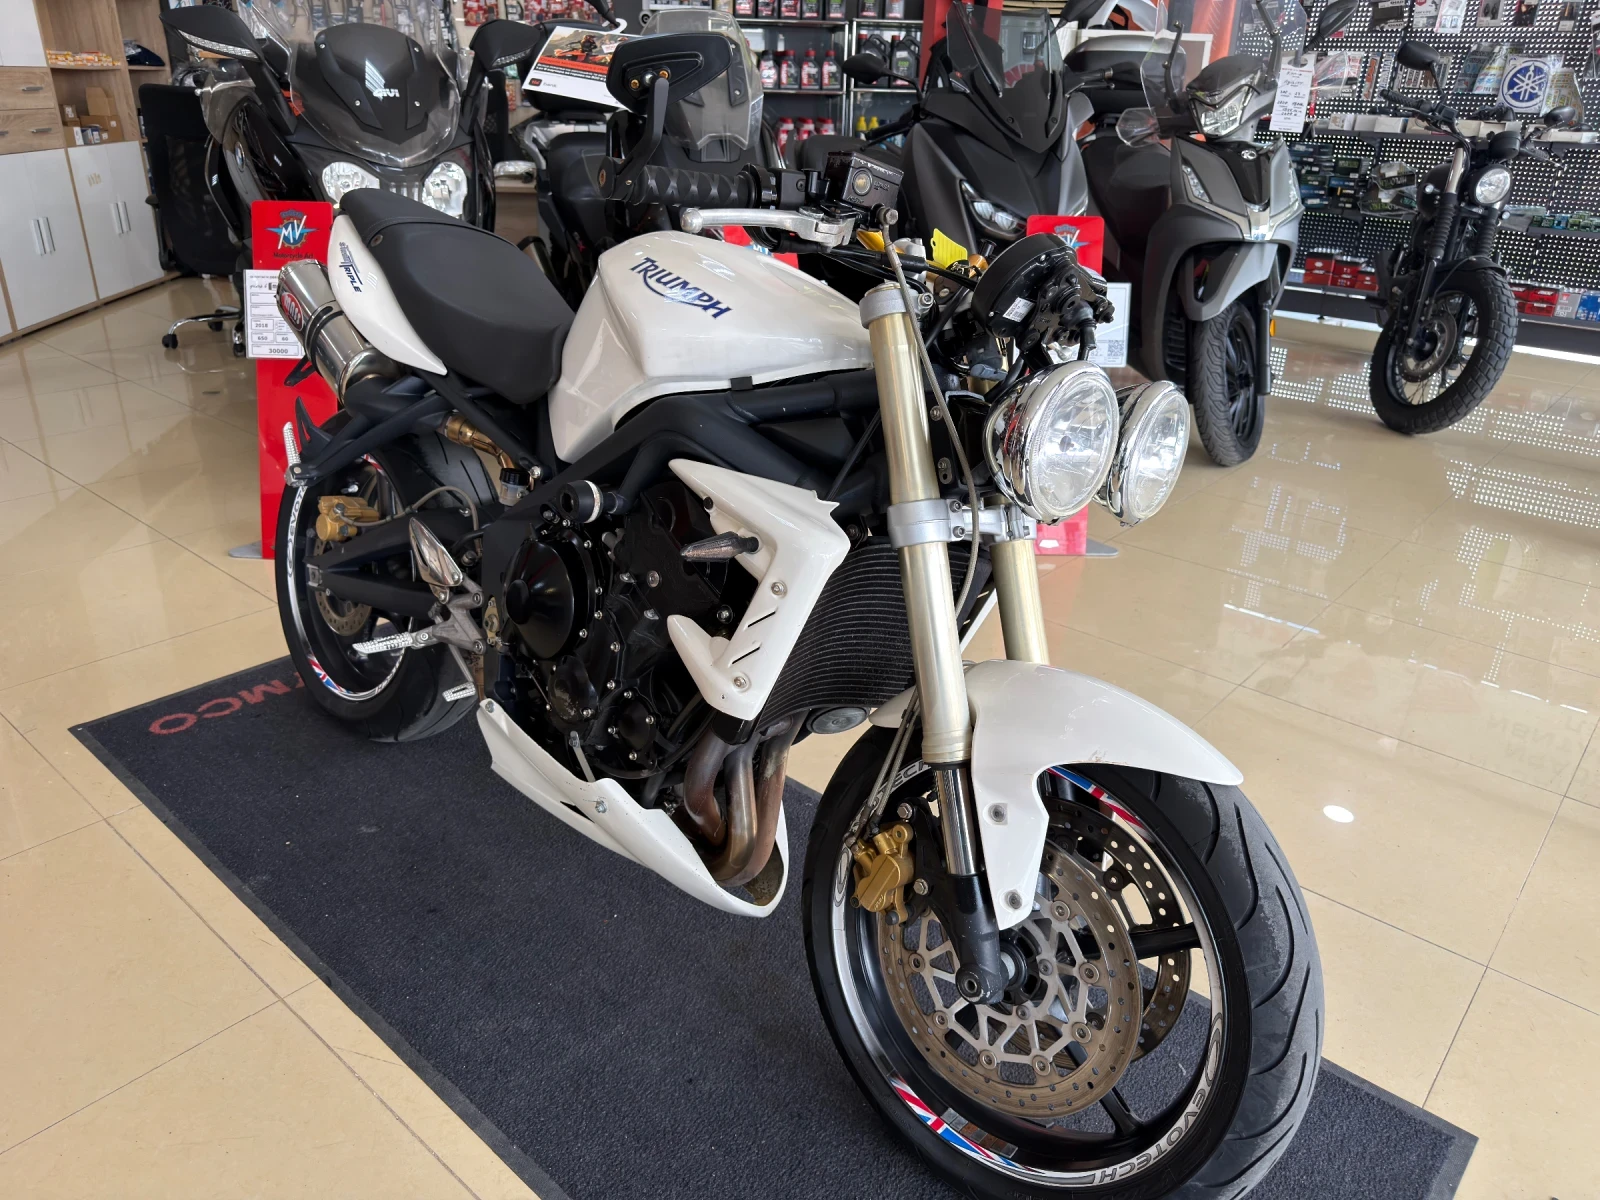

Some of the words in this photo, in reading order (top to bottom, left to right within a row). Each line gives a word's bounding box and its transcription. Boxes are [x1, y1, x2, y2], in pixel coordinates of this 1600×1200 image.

[277, 215, 307, 250] MV
[629, 256, 733, 320] TRIUMPH
[1099, 1088, 1206, 1184] EVOTECH
